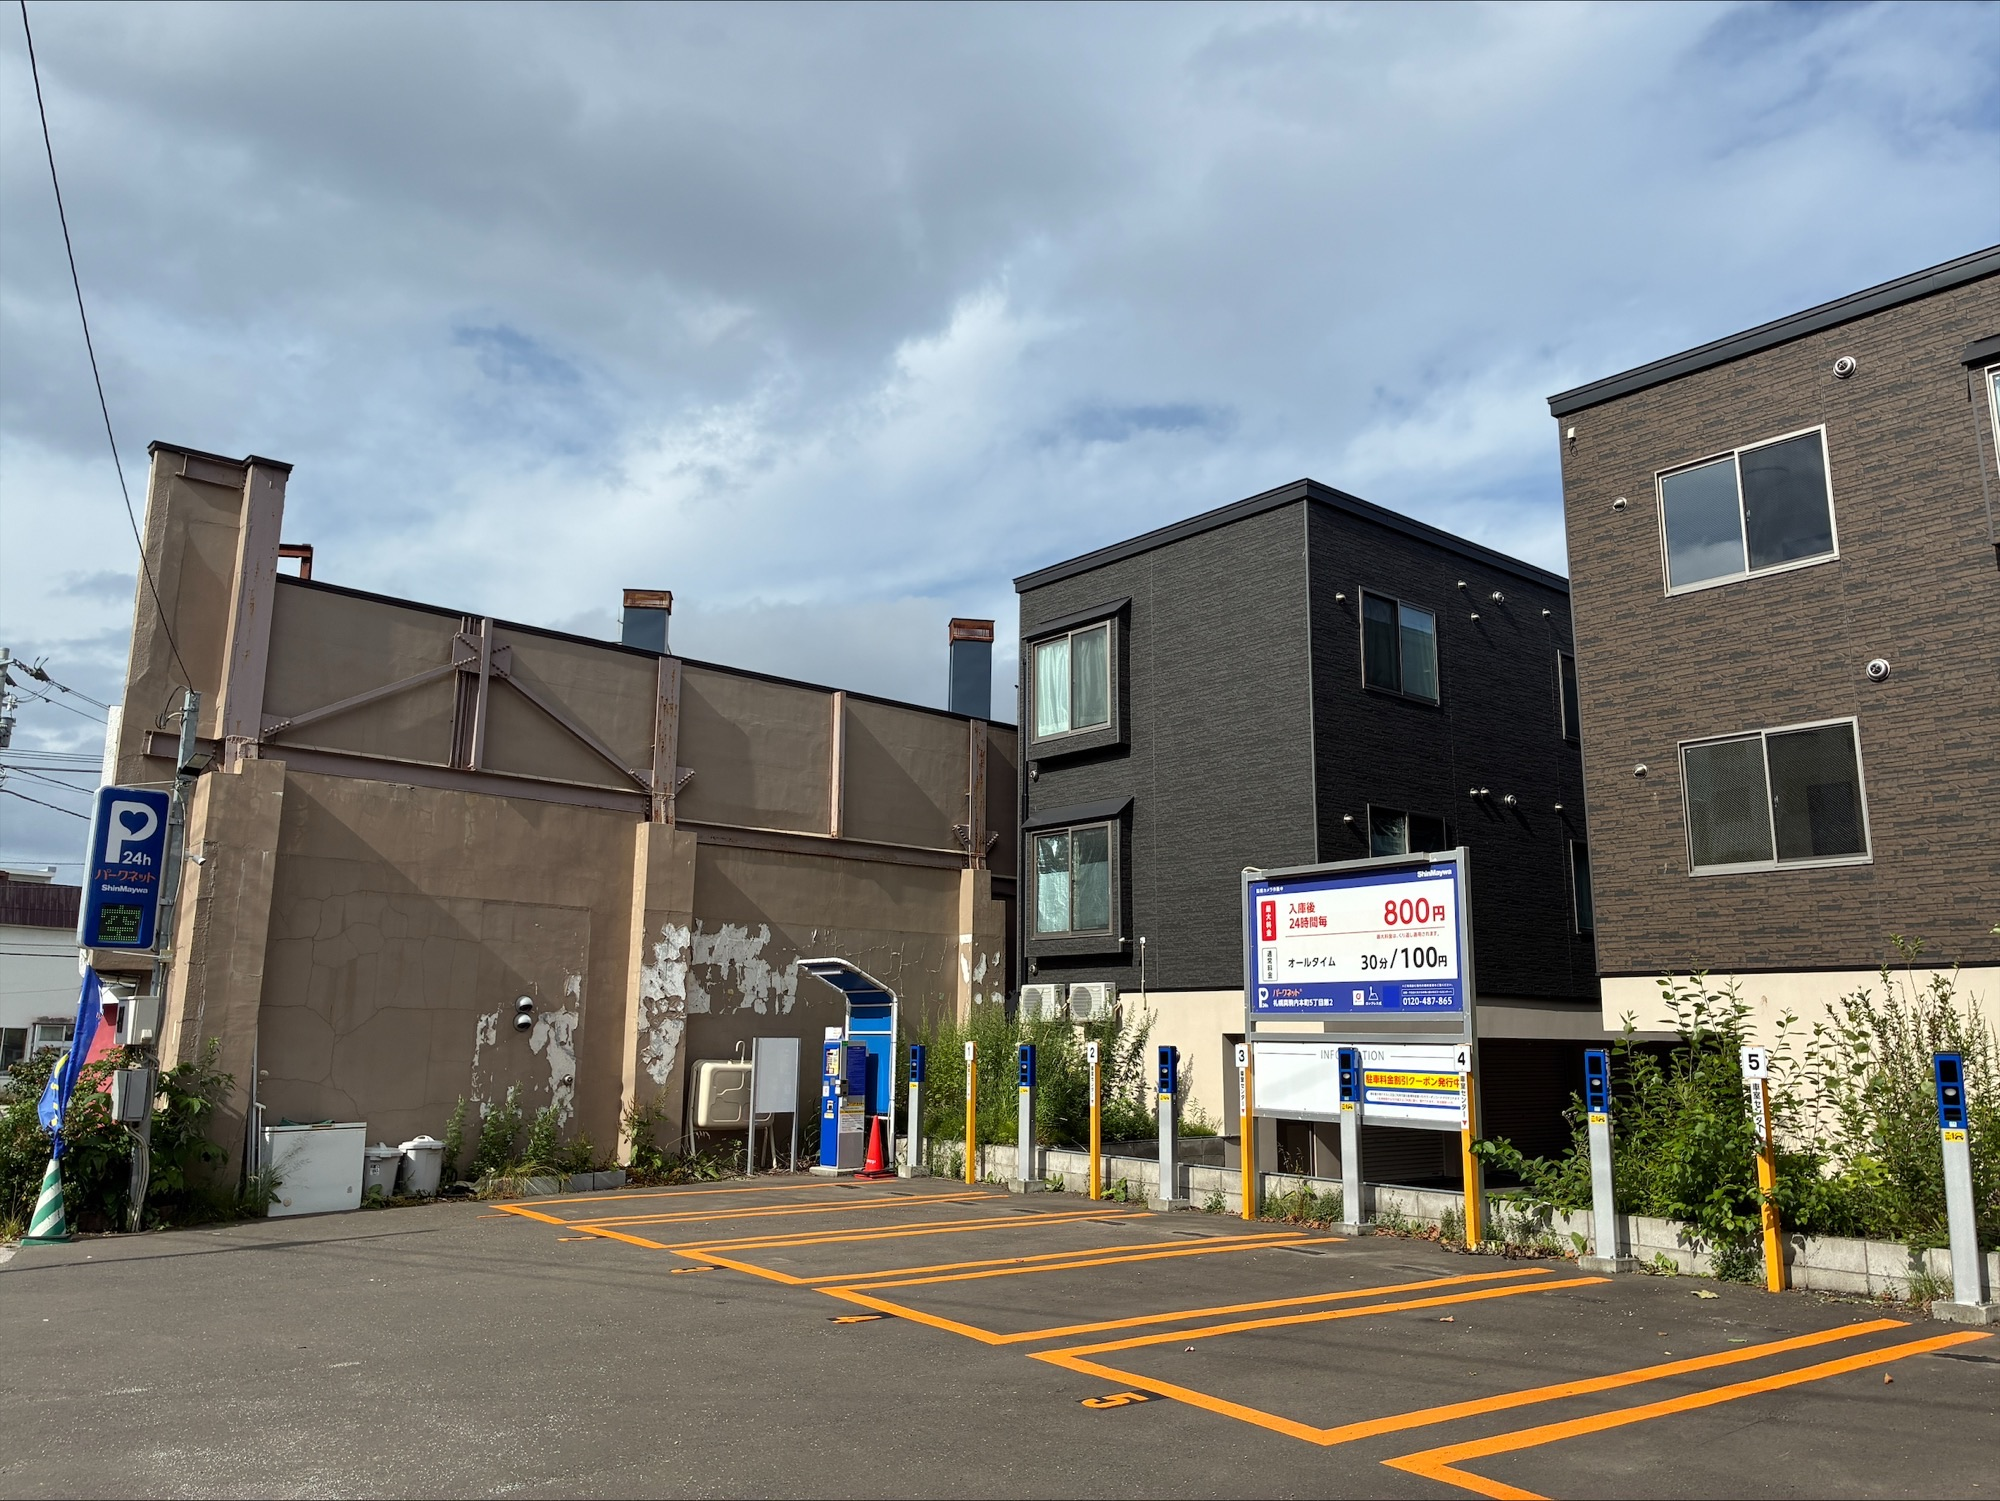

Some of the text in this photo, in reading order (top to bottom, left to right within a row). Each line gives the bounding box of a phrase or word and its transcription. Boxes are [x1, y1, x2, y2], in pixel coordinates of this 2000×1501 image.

[122, 850, 152, 866] 24h
[95, 869, 156, 883] パークネット
[1417, 869, 1452, 878] ShinMaywa
[101, 884, 149, 894] ShinMaywa
[1289, 902, 1316, 914] 入庫後
[1384, 897, 1445, 926] 800円
[1265, 905, 1273, 937] 最大料金
[1289, 916, 1328, 929] 24時間毎
[1287, 957, 1336, 968] オールタイム
[1361, 946, 1448, 970] 30分/100円
[1402, 996, 1453, 1006] 0120-487-865
[1090, 1047, 1095, 1058] 2
[1238, 1049, 1245, 1062] 3
[1457, 1051, 1466, 1066] 4
[1748, 1053, 1760, 1071] 5
[1081, 1392, 1149, 1409] 5
